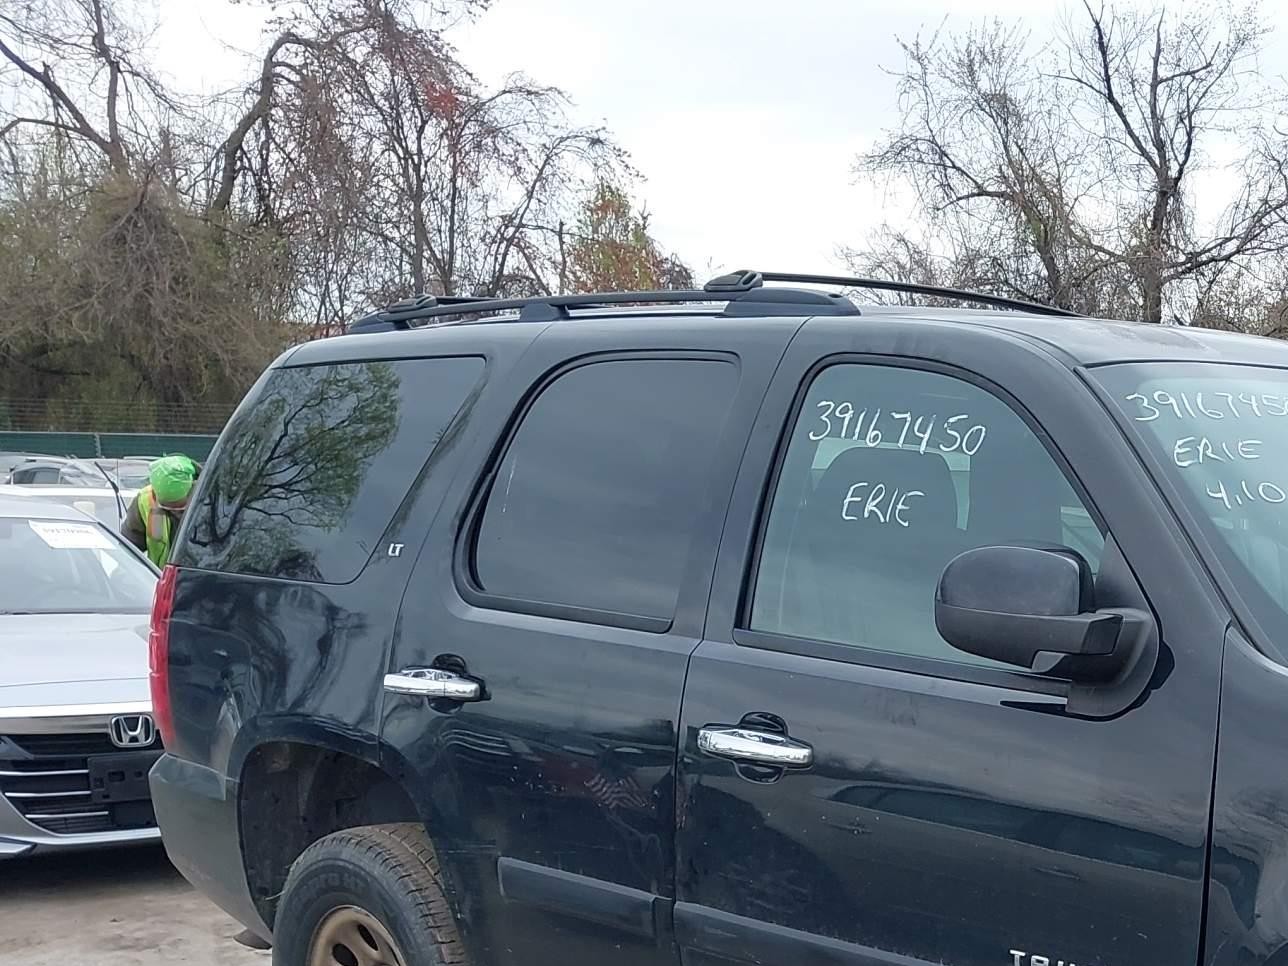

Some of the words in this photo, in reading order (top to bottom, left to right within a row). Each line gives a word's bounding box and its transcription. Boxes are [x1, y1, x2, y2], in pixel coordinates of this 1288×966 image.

[808, 400, 986, 456] 39167450
[1173, 436, 1263, 468] ERIE
[841, 482, 925, 527] ERIE
[388, 543, 405, 557] LT
